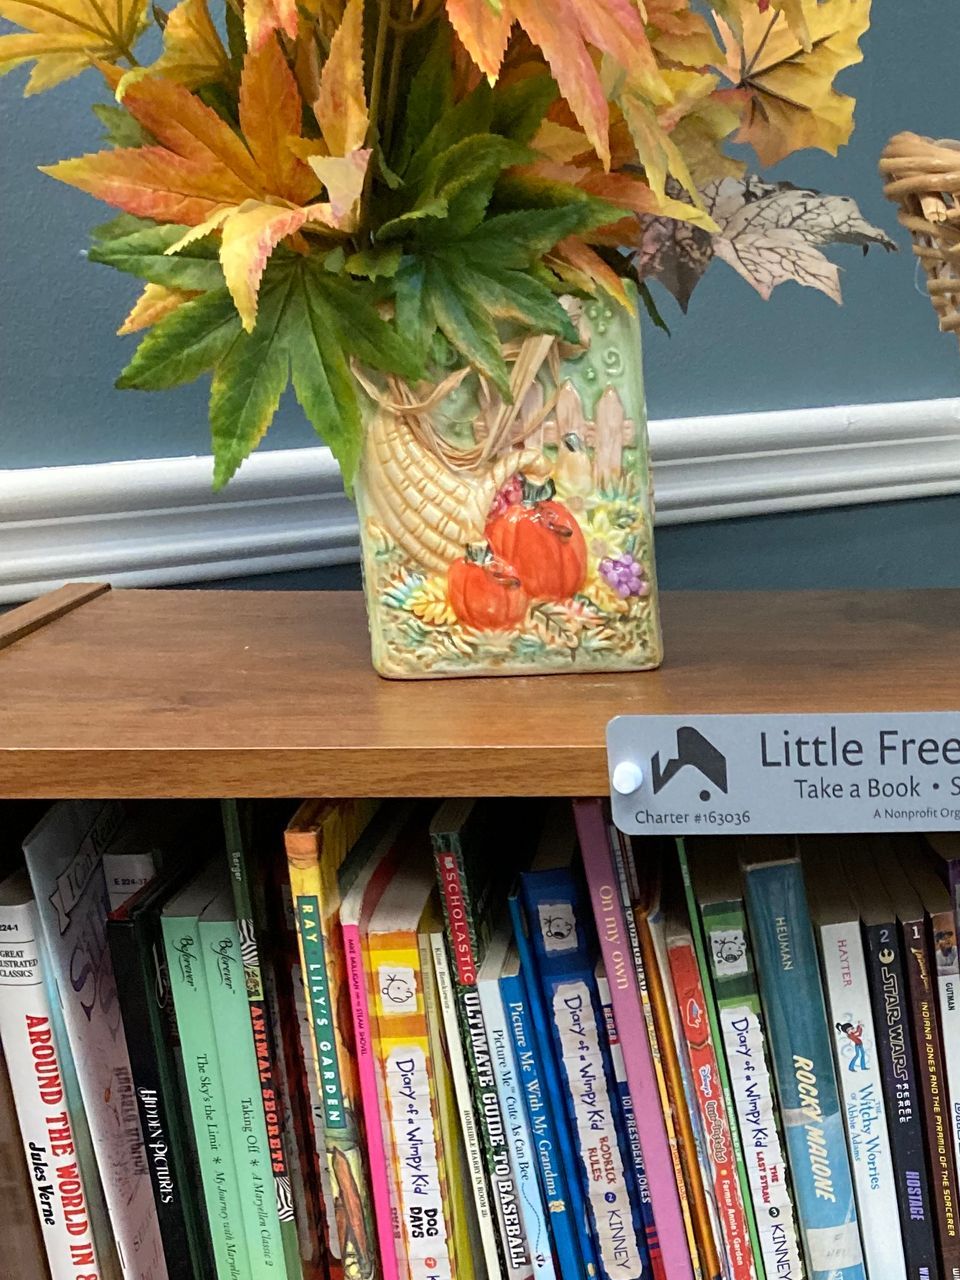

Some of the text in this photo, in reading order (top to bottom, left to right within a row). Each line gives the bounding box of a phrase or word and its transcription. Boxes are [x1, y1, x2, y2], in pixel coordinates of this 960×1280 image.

[760, 728, 864, 767] Little
[793, 778, 841, 799] Take
[848, 785, 860, 798] a
[867, 776, 920, 798] Book
[635, 810, 750, 825] Charter #163036
[873, 809, 880, 819] A
[883, 807, 937, 820] Nonprofit
[598, 886, 630, 990] On my own
[775, 917, 793, 970] HEUMAN
[838, 940, 852, 987] HAYTER
[302, 904, 340, 1122] RAY LILY'S GARDEN
[946, 982, 955, 1011] GUTMAN
[510, 1002, 528, 1048] Picture
[882, 968, 908, 1080] STAR WARS
[26, 1014, 60, 1105] AROUND
[396, 1058, 417, 1100] Diary
[446, 872, 526, 1269] SCHOLASTIC ULTIMATE GUIDE TO BASEBALL
[196, 1054, 220, 1150] The Sky's the Limit
[406, 1104, 418, 1114] of
[527, 1080, 548, 1112] With
[896, 1084, 906, 1123] FORCE
[902, 1083, 912, 1122] REBEL
[46, 1112, 72, 1158] THE
[532, 1115, 550, 1136] My
[793, 1055, 836, 1202] ROCKY MALONE
[858, 1084, 884, 1190] Witchy Worries
[406, 1128, 425, 1172] Wimpy
[538, 1140, 560, 1195] Grandma
[28, 1142, 56, 1226] Jules Verne
[56, 1164, 89, 1236] WORLD
[413, 1174, 429, 1195] Kid
[905, 1170, 924, 1220] HOSTAGE
[410, 1206, 424, 1238] DAYS
[424, 1208, 438, 1237] DOG
[70, 1245, 94, 1266] IN
